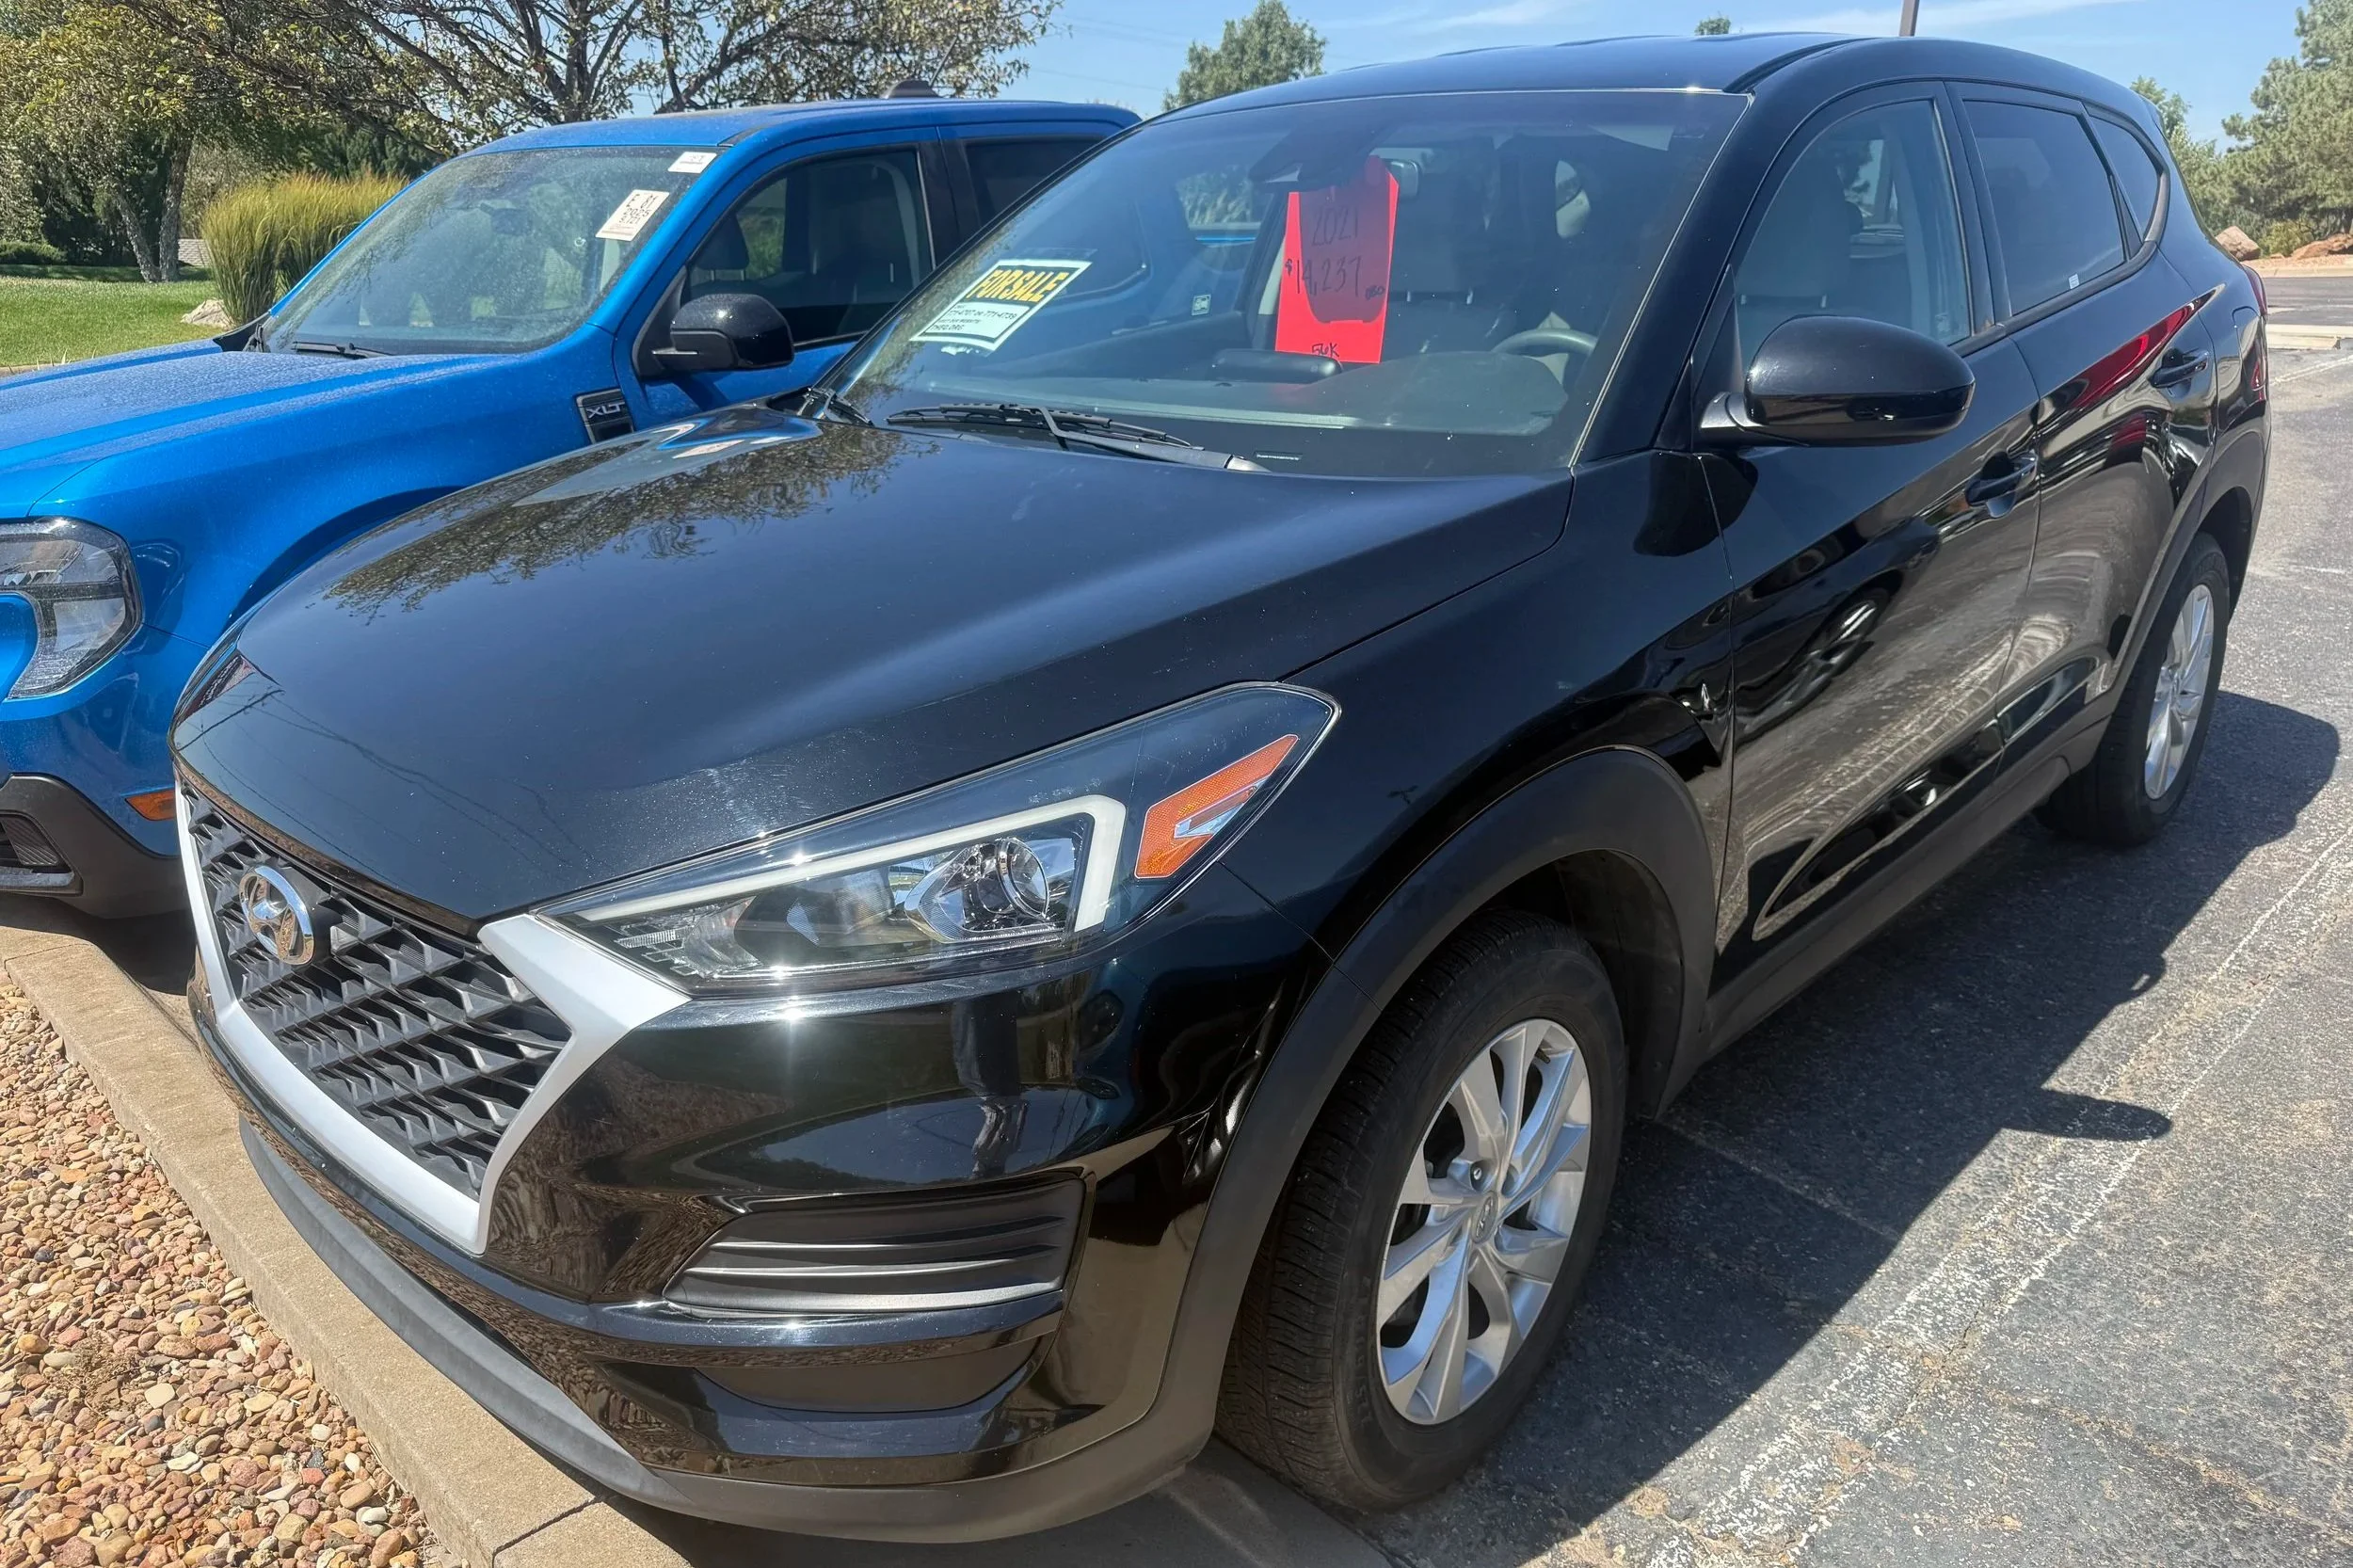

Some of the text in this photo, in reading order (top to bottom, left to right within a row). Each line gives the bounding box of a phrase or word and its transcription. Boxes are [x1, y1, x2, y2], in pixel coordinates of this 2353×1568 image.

[622, 208, 651, 217] 2025
[1311, 206, 1359, 247] 2021
[966, 270, 1069, 302] FOR SALE
[585, 401, 626, 419] XLT
